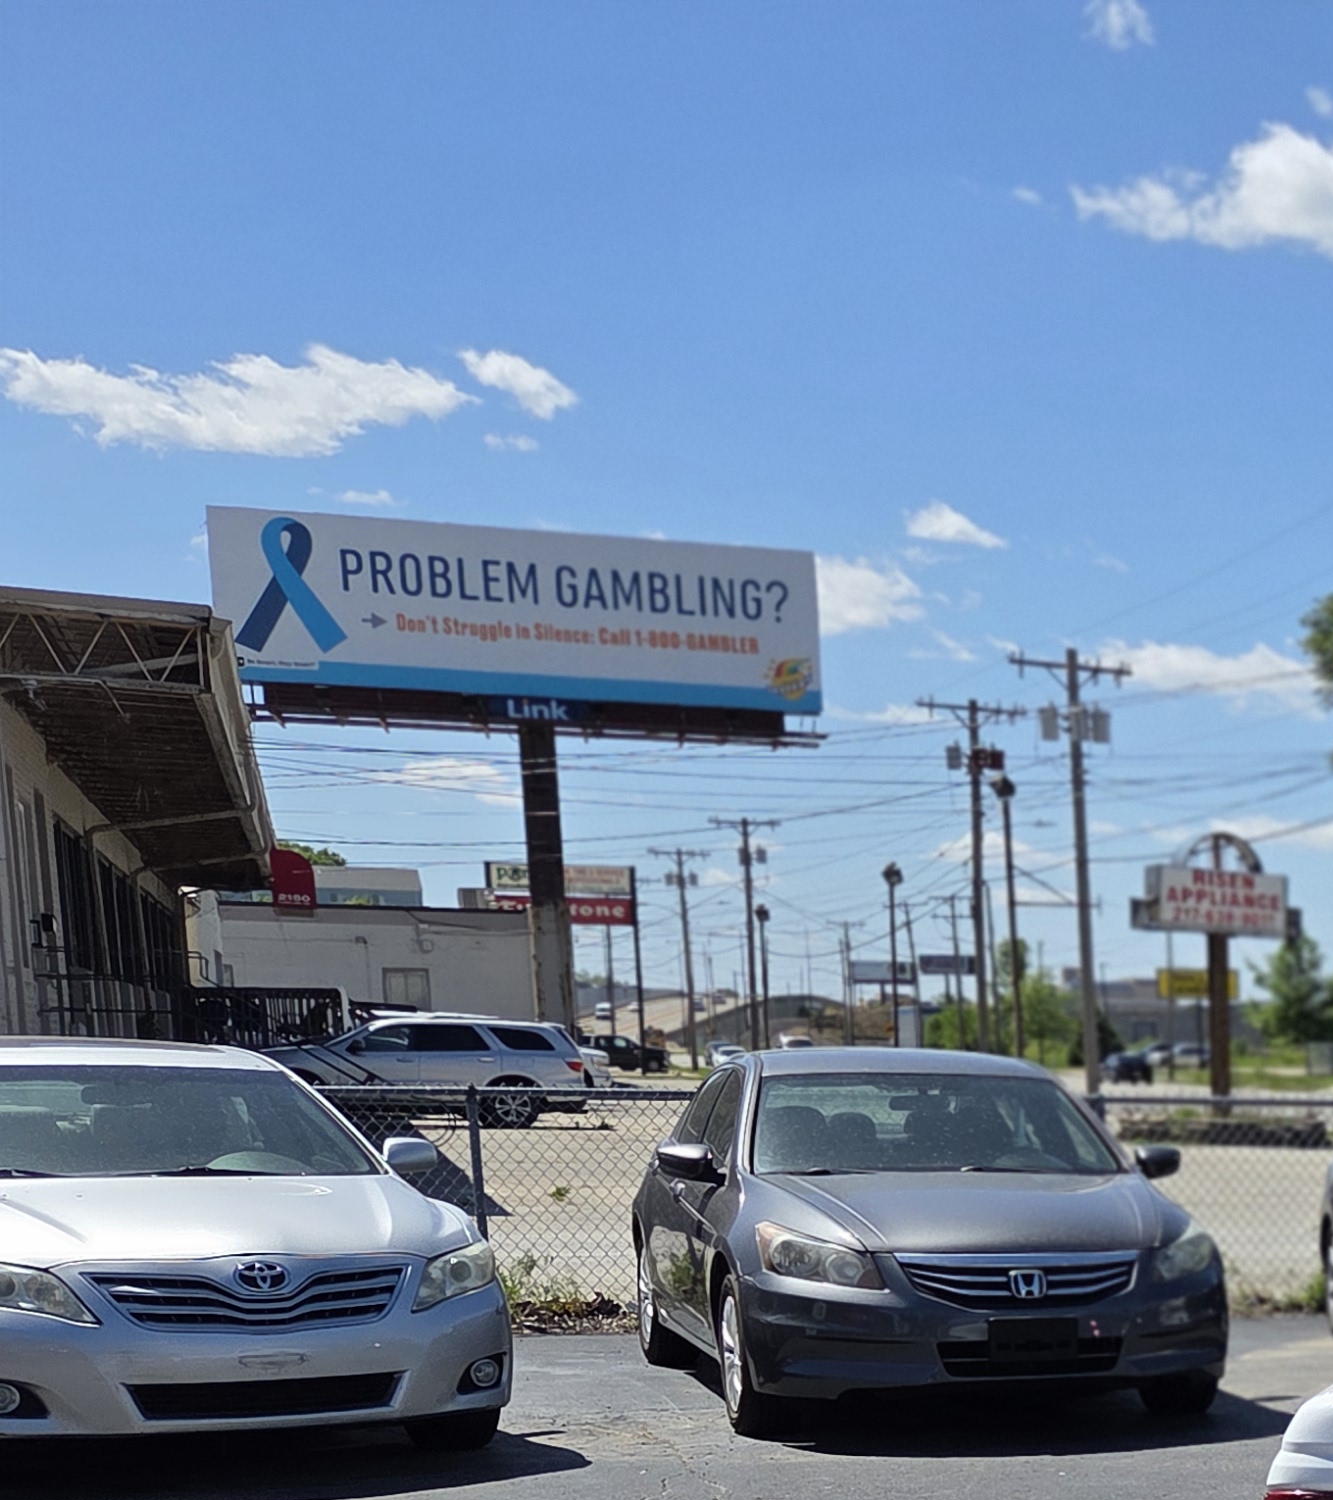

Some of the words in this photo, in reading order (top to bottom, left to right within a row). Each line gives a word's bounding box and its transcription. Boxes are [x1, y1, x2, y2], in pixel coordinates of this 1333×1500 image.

[339, 548, 539, 605] PROBLEM
[555, 564, 789, 624] GAMBLING?
[395, 612, 439, 635] Don't
[442, 616, 512, 643] Struggle
[534, 622, 595, 644] Silence:
[599, 626, 631, 646] Call
[635, 629, 759, 655] 1-800-GAMBLER
[507, 698, 568, 720] Link
[1167, 885, 1279, 911] APPLIANCE
